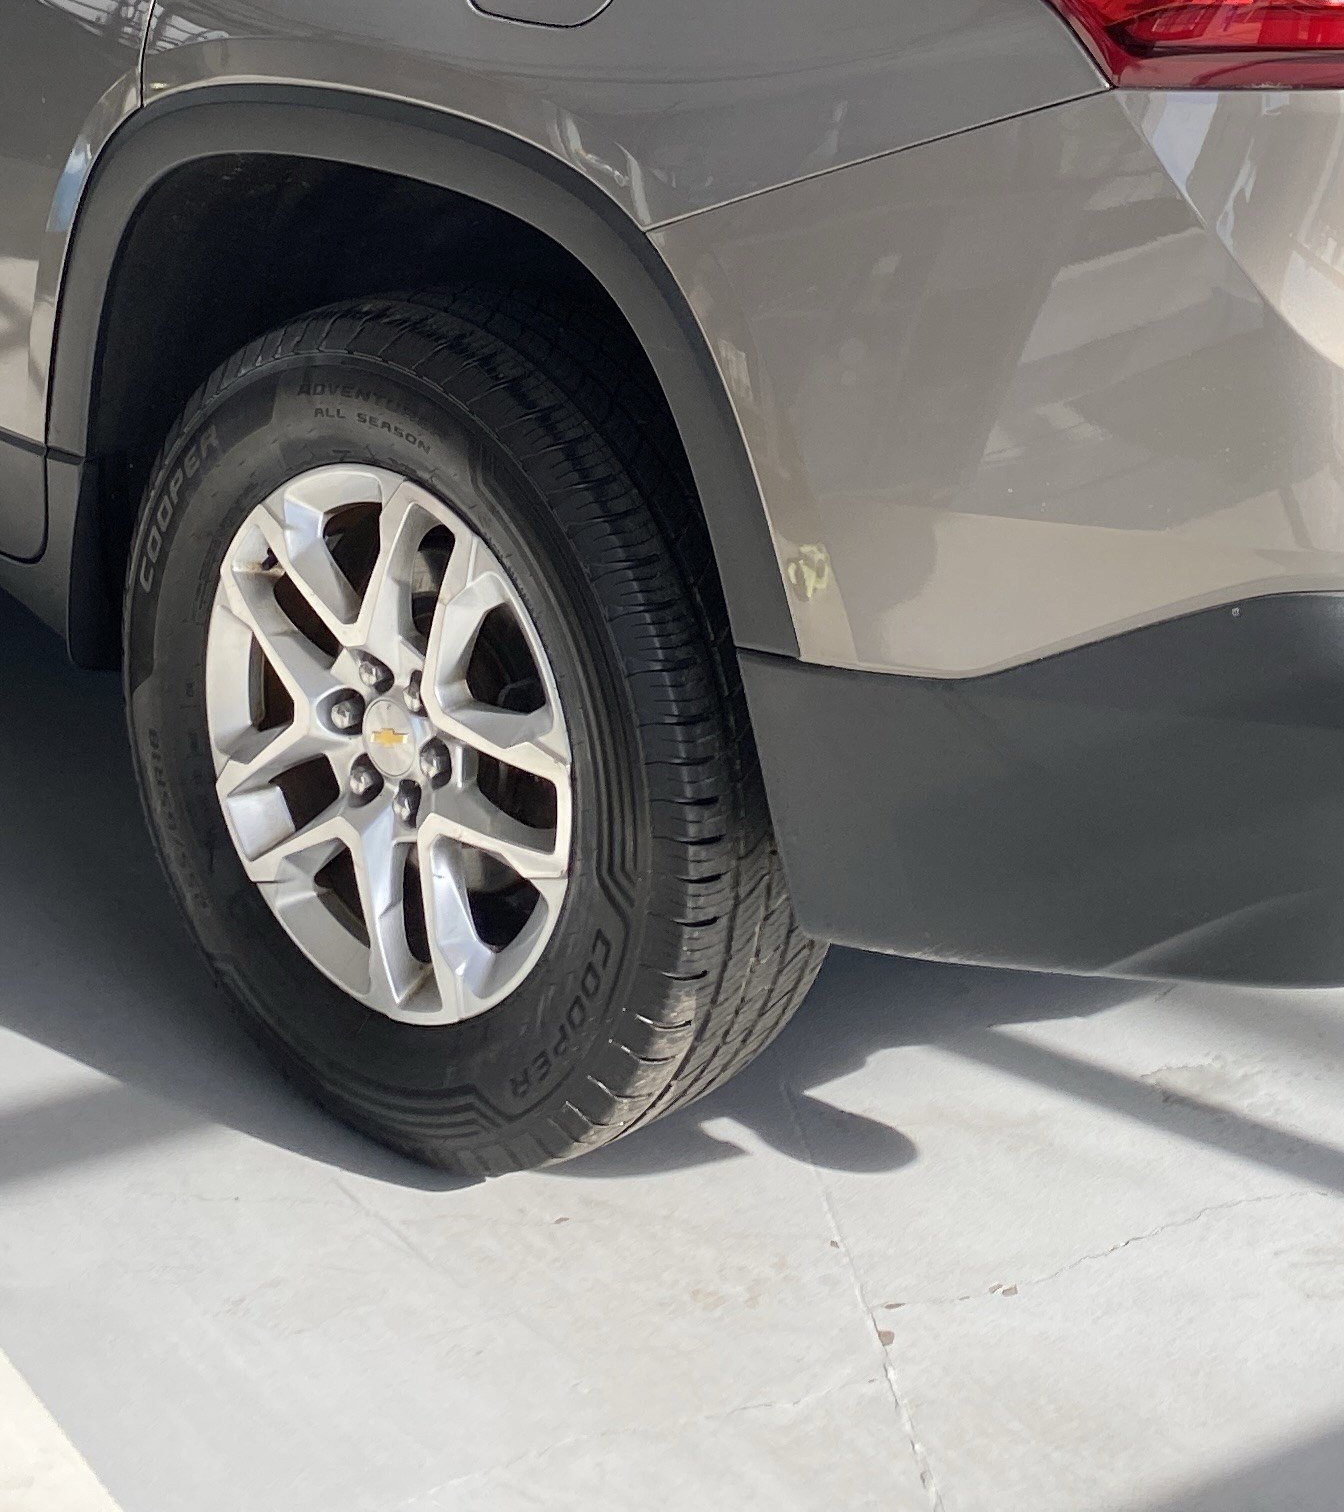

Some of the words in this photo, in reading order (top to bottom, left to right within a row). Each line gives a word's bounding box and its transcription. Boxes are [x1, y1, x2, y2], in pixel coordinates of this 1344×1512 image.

[139, 424, 221, 593] COOPER
[314, 407, 347, 419] ALL
[357, 412, 431, 455] SEASON
[509, 927, 612, 1099] COOPER
